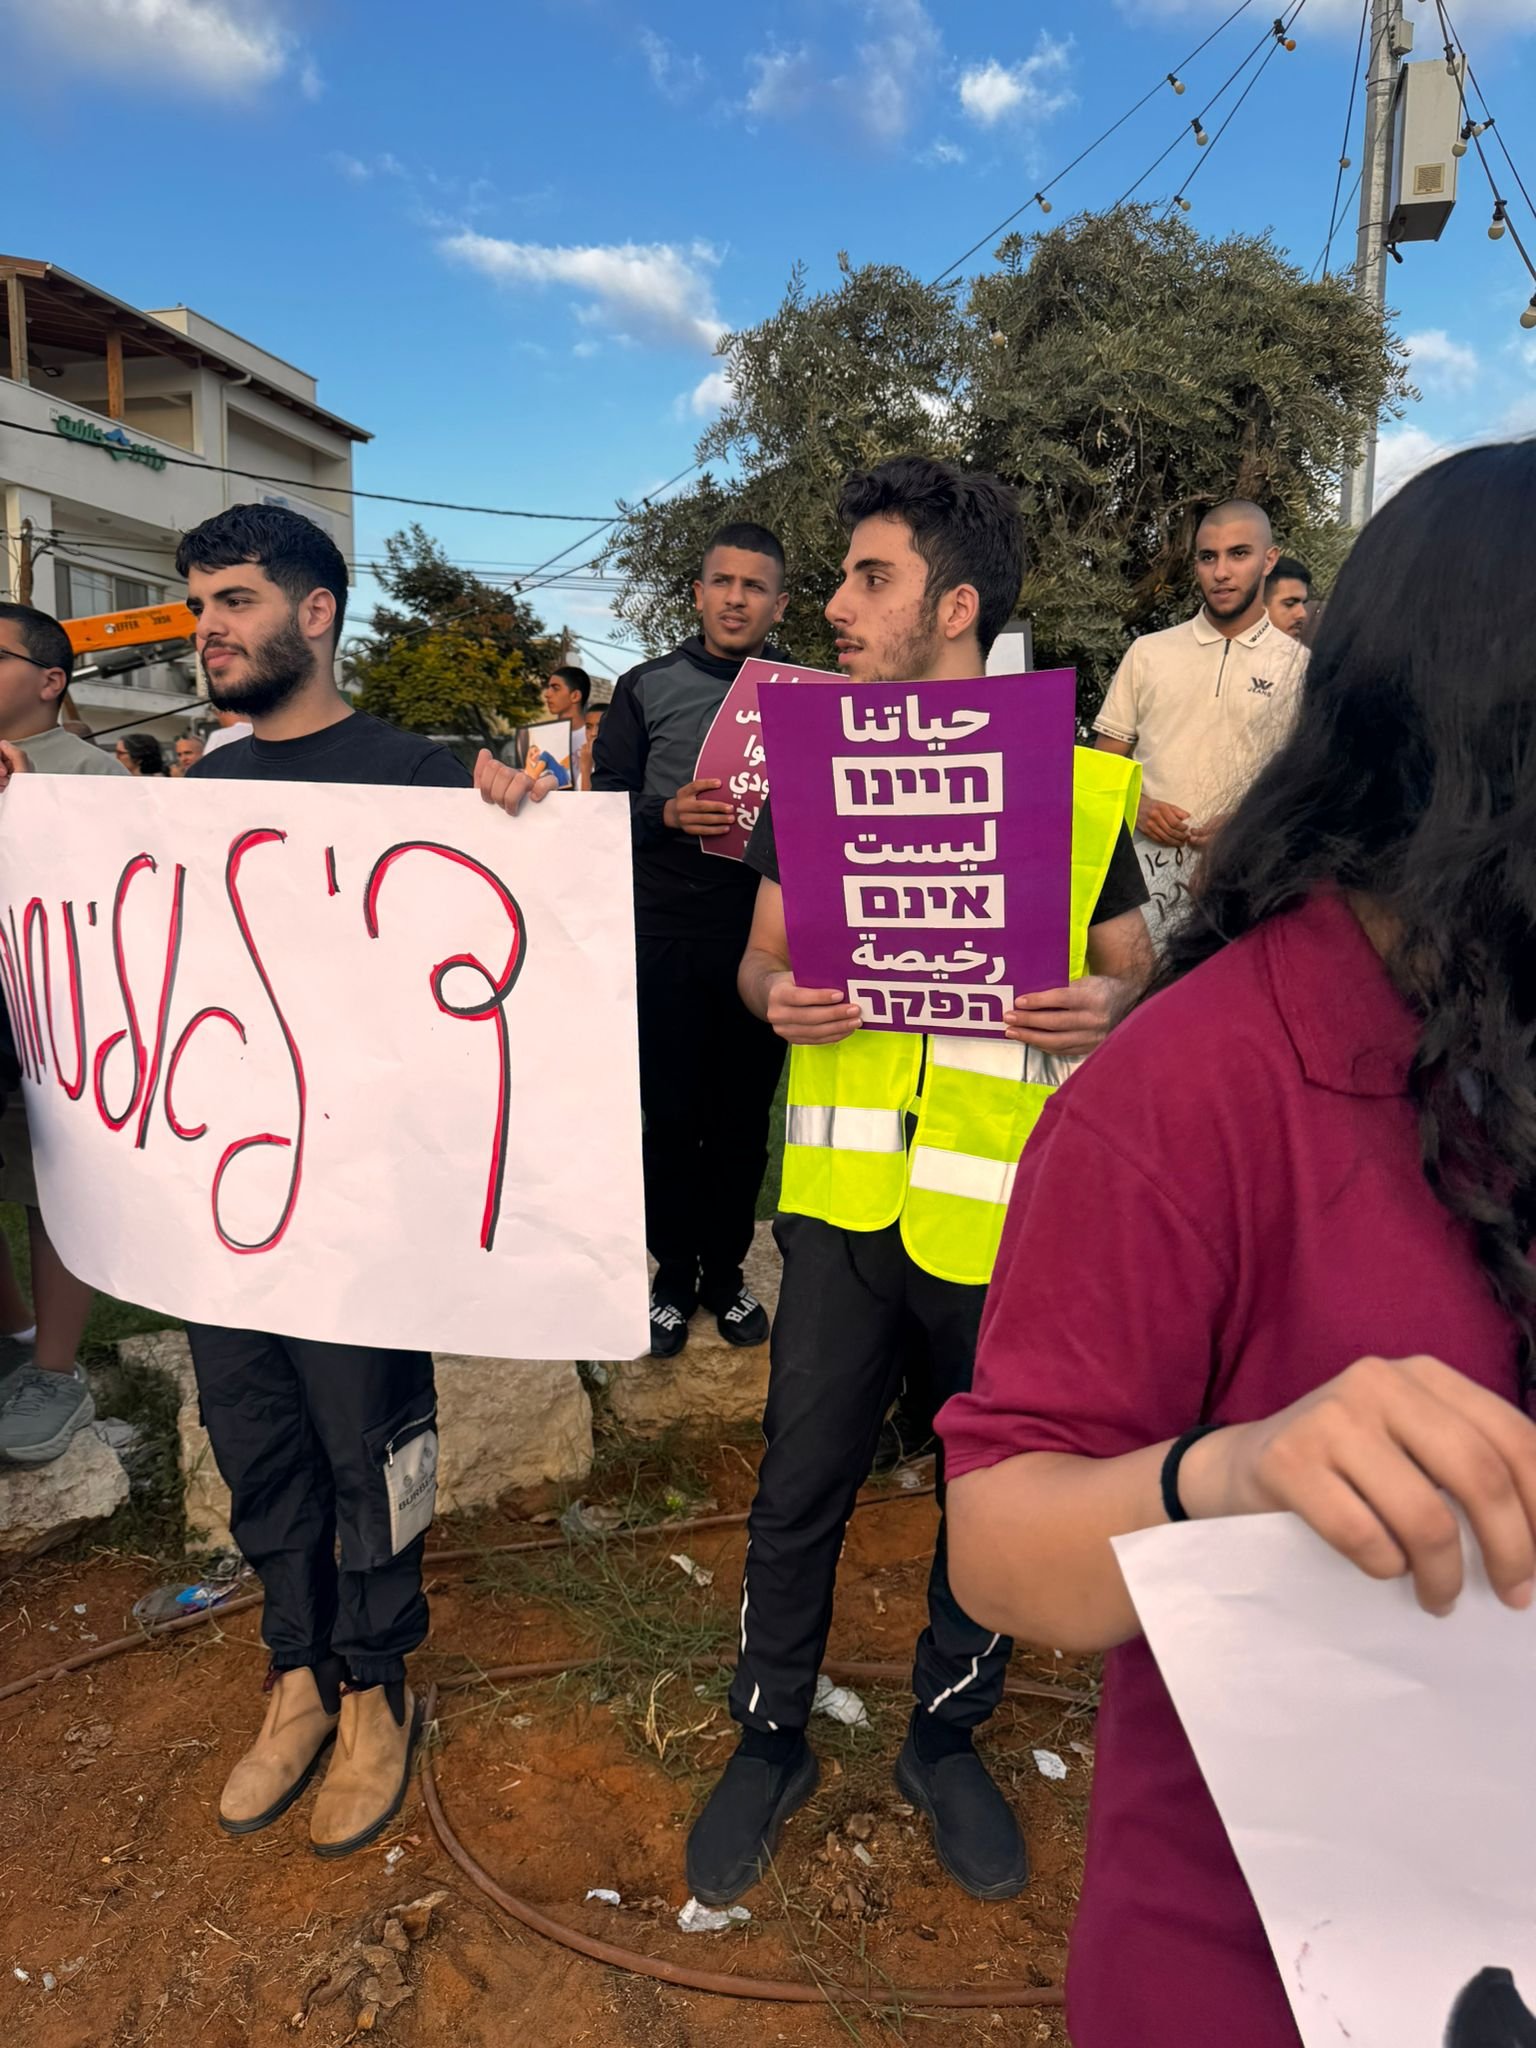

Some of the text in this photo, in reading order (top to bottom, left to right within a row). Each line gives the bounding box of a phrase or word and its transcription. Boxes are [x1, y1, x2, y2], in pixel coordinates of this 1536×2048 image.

[1247, 687, 1272, 698] JEANS
[841, 694, 990, 751] حياتنا
[845, 766, 989, 806] חיינו
[845, 819, 997, 872] ليست
[859, 886, 992, 919] אינם
[851, 933, 1006, 984] رخيصة
[856, 988, 1004, 1024] הפקר
[325, 841, 528, 1253] די
